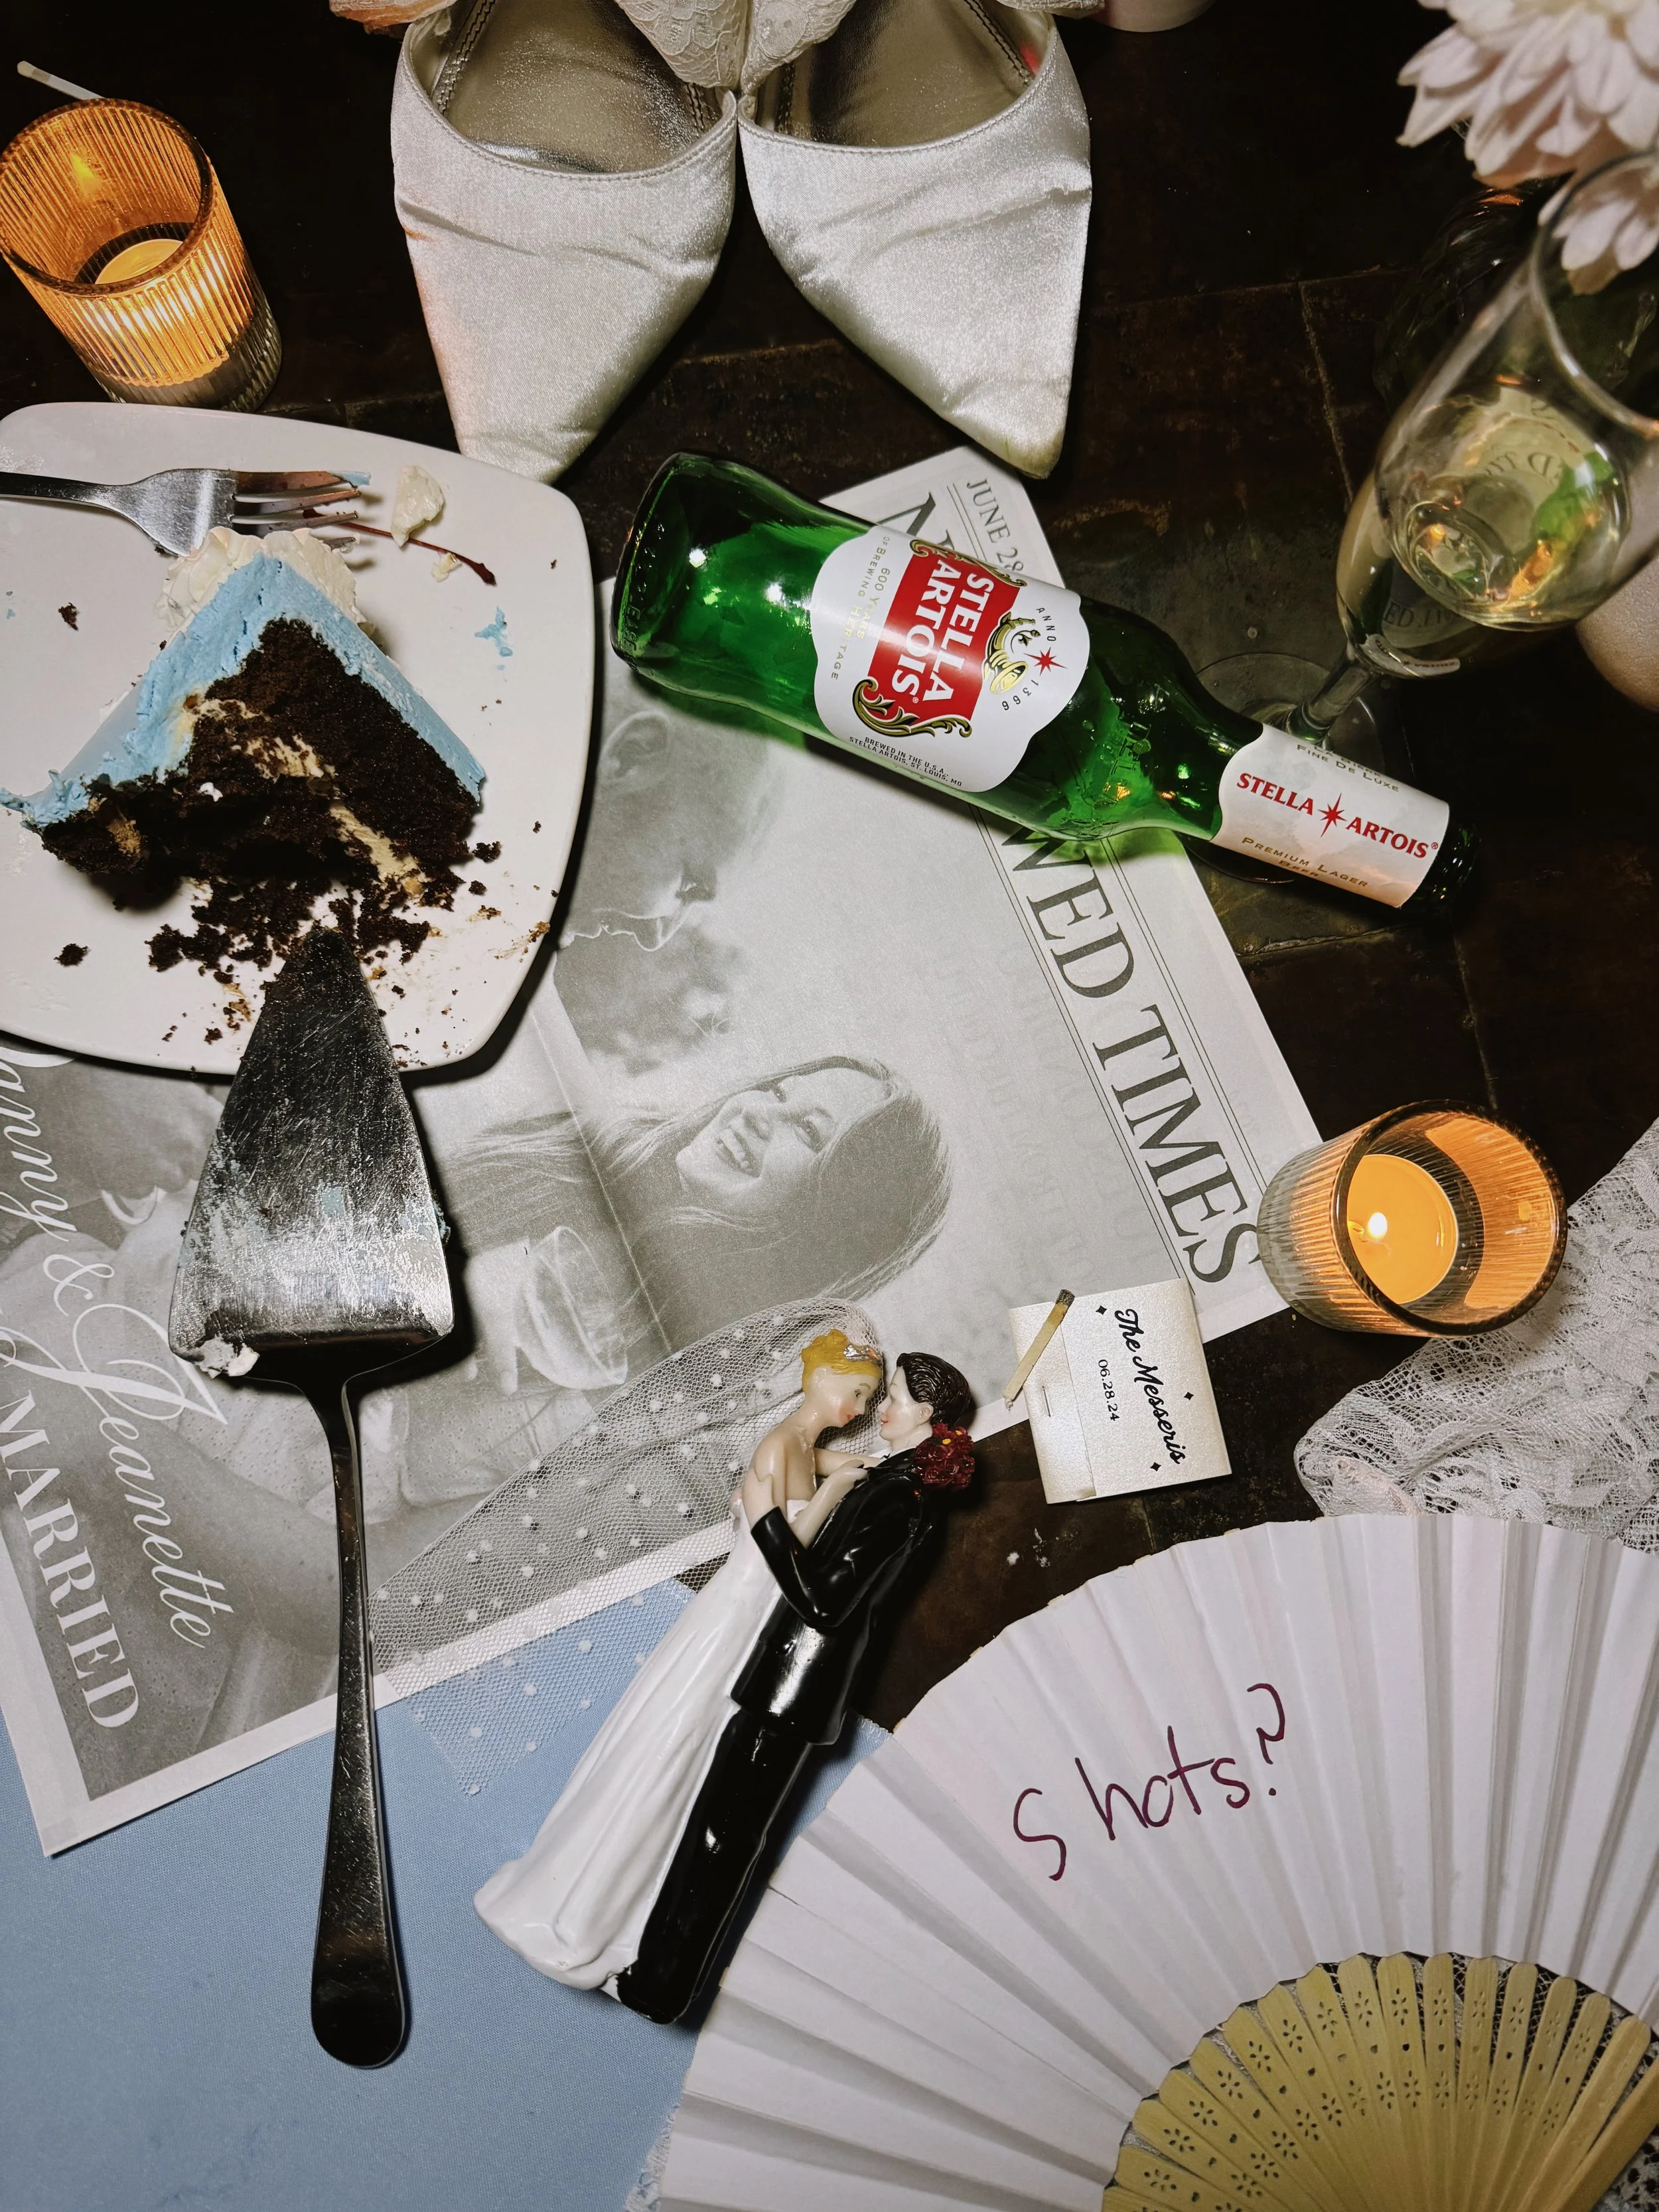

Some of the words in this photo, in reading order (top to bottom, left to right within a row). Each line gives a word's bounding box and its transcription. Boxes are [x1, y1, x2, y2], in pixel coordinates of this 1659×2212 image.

[966, 478, 1011, 544] JUNE
[881, 536, 891, 547] OF
[857, 547, 887, 598] BREWING
[874, 567, 891, 591] 600
[857, 597, 881, 639] YEARS
[922, 571, 995, 702] STELLA
[1035, 607, 1057, 642] ANNO
[1001, 679, 1039, 711] 1366
[849, 737, 877, 752] STELLA
[879, 749, 908, 765] ARTOIS,
[910, 762, 922, 771] ST.
[924, 767, 948, 782] LOUIS,
[950, 778, 962, 787] MO
[864, 737, 896, 754] BREWED
[908, 755, 923, 765] THE
[1297, 744, 1329, 763] FINE
[1336, 761, 1356, 774] DE
[1362, 772, 1400, 792] LUXE
[1236, 773, 1314, 816] STELLA
[1242, 836, 1310, 867] PREMIUM
[1317, 864, 1368, 888] LAGER
[1092, 1003, 1262, 1284] TIMES
[43, 1254, 115, 1317] &
[1098, 1359, 1120, 1422] 06.28.24
[1114, 1308, 1145, 1353] The
[1131, 1355, 1187, 1465] Messeris
[0, 1304, 234, 1649] Jeanette
[0, 1389, 139, 1728] MARRIED
